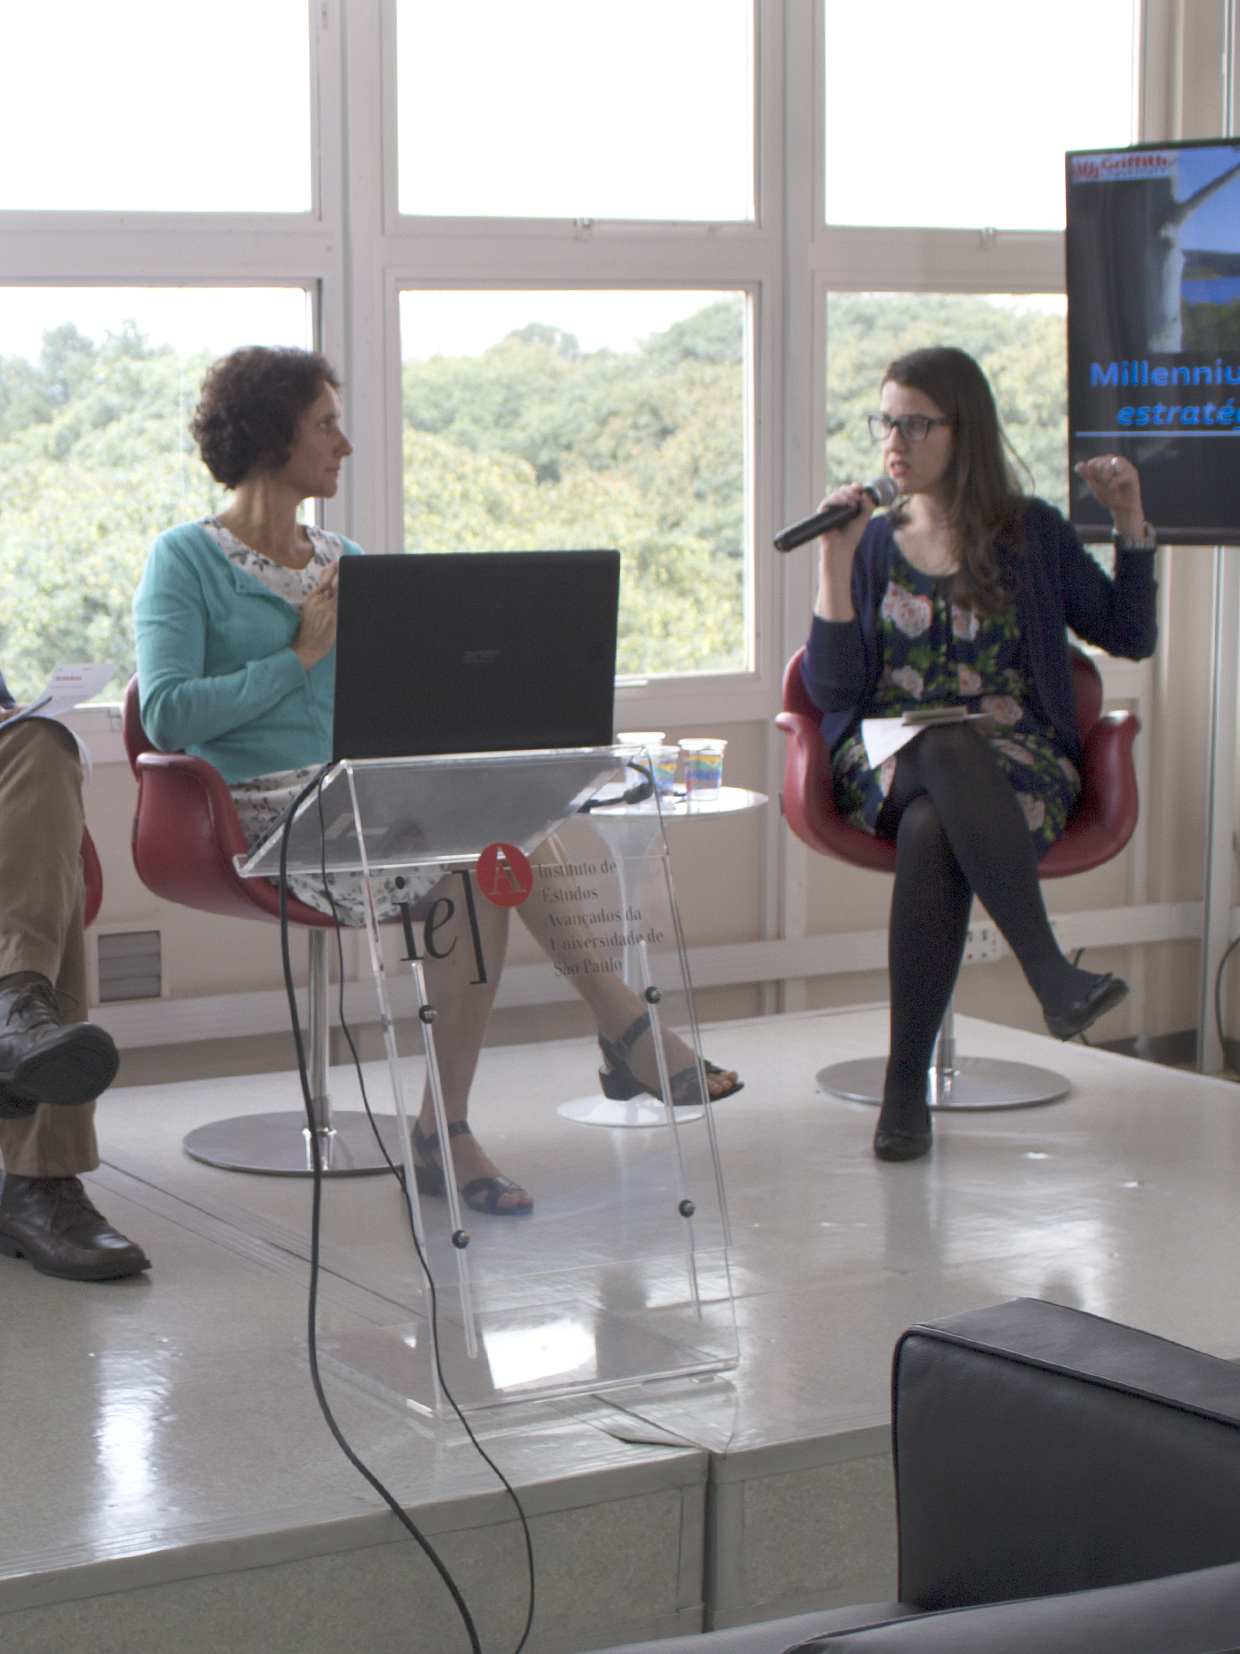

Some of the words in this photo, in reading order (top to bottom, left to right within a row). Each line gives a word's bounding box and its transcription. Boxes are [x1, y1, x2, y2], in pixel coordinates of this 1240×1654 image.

[1101, 153, 1168, 170] Griffith
[1090, 358, 1240, 387] Millenniu
[1117, 398, 1240, 431] estraté
[538, 861, 597, 879] Instituto
[600, 859, 618, 875] de
[542, 886, 598, 903] Estudos
[548, 908, 622, 929] Avançados
[626, 905, 642, 921] da
[550, 930, 644, 952] Universidade
[647, 927, 664, 944] de
[554, 960, 579, 977] São
[583, 957, 623, 974] Paulo
